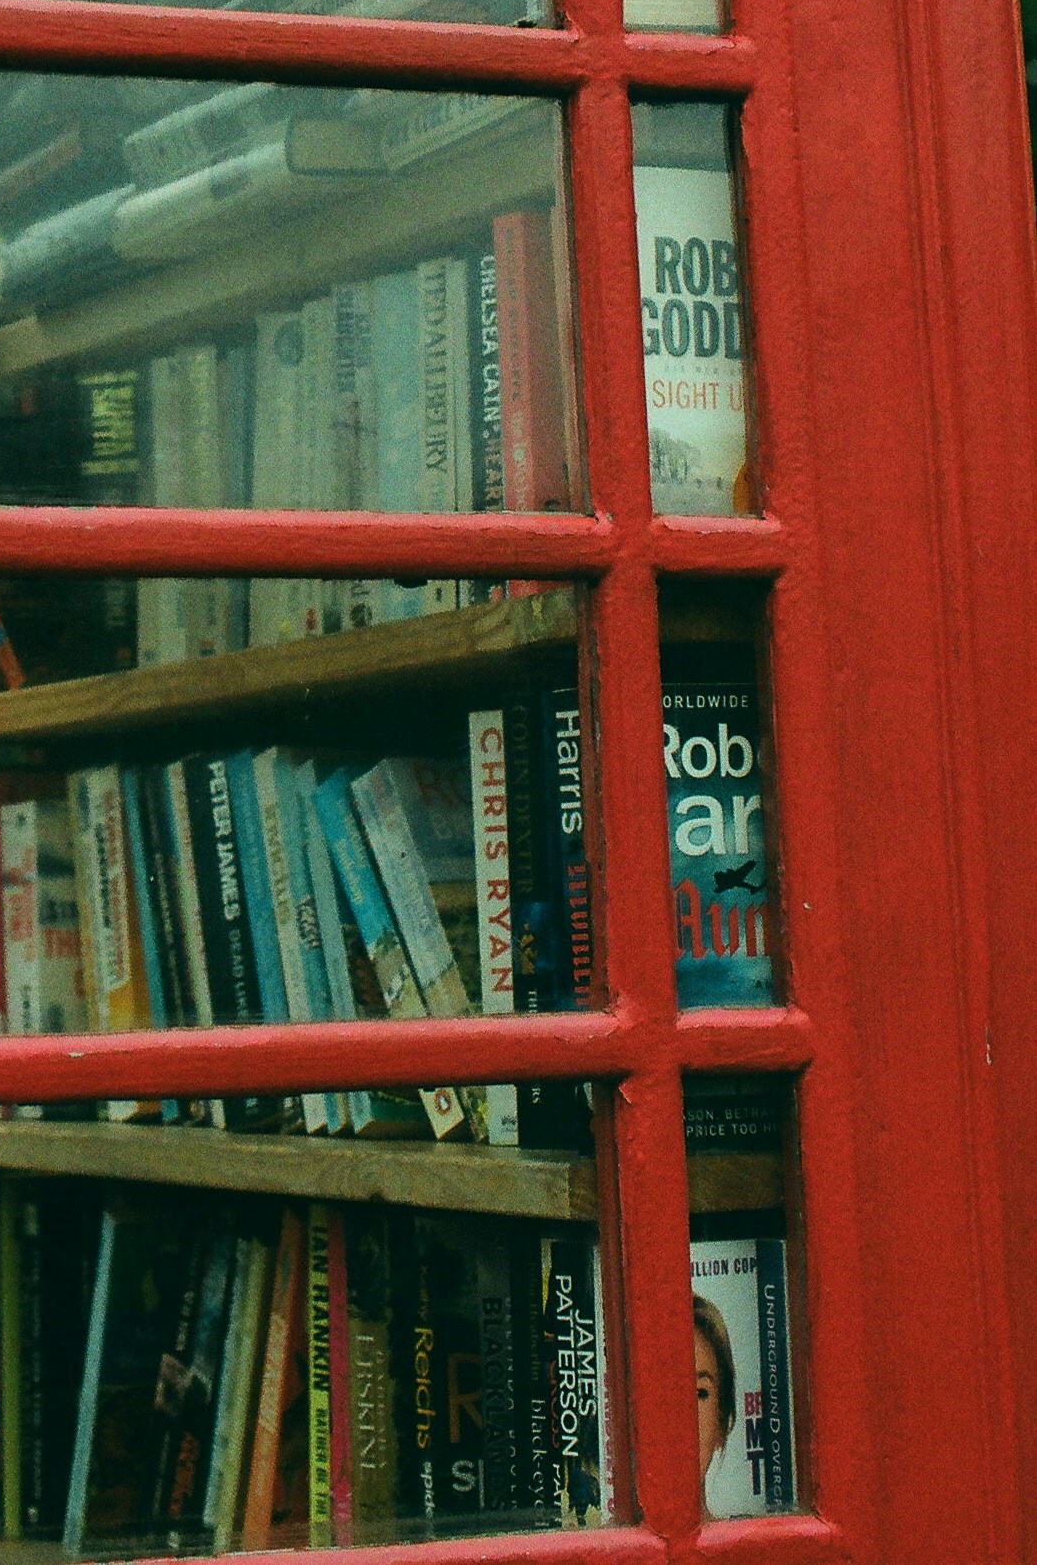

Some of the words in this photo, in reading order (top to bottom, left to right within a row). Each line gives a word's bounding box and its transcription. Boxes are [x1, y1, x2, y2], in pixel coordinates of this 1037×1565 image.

[481, 255, 499, 356] CHELSEA
[483, 364, 501, 423] CAIN
[652, 379, 719, 409] SIGHT
[728, 380, 745, 412] U
[662, 695, 749, 708] ORLDWIDE
[556, 709, 583, 834] Harris
[663, 723, 762, 779] Rob
[208, 760, 233, 838] PETER
[479, 726, 507, 861] CHRIS
[676, 795, 761, 856] ar
[217, 843, 241, 922] JAMES
[486, 878, 512, 992] RYAN
[686, 1124, 725, 1137] PRICE
[731, 1123, 757, 1135] TOO
[312, 1226, 329, 1273] IAN
[691, 1258, 729, 1277] ILLION
[734, 1256, 757, 1275] COP
[312, 1285, 329, 1392] RANKIN
[556, 1274, 579, 1457] PATTERSON
[575, 1309, 598, 1417] JAMES
[764, 1284, 782, 1433] UNDERGROUND
[414, 1327, 436, 1450] Reichs
[770, 1439, 785, 1508] OVERGR
